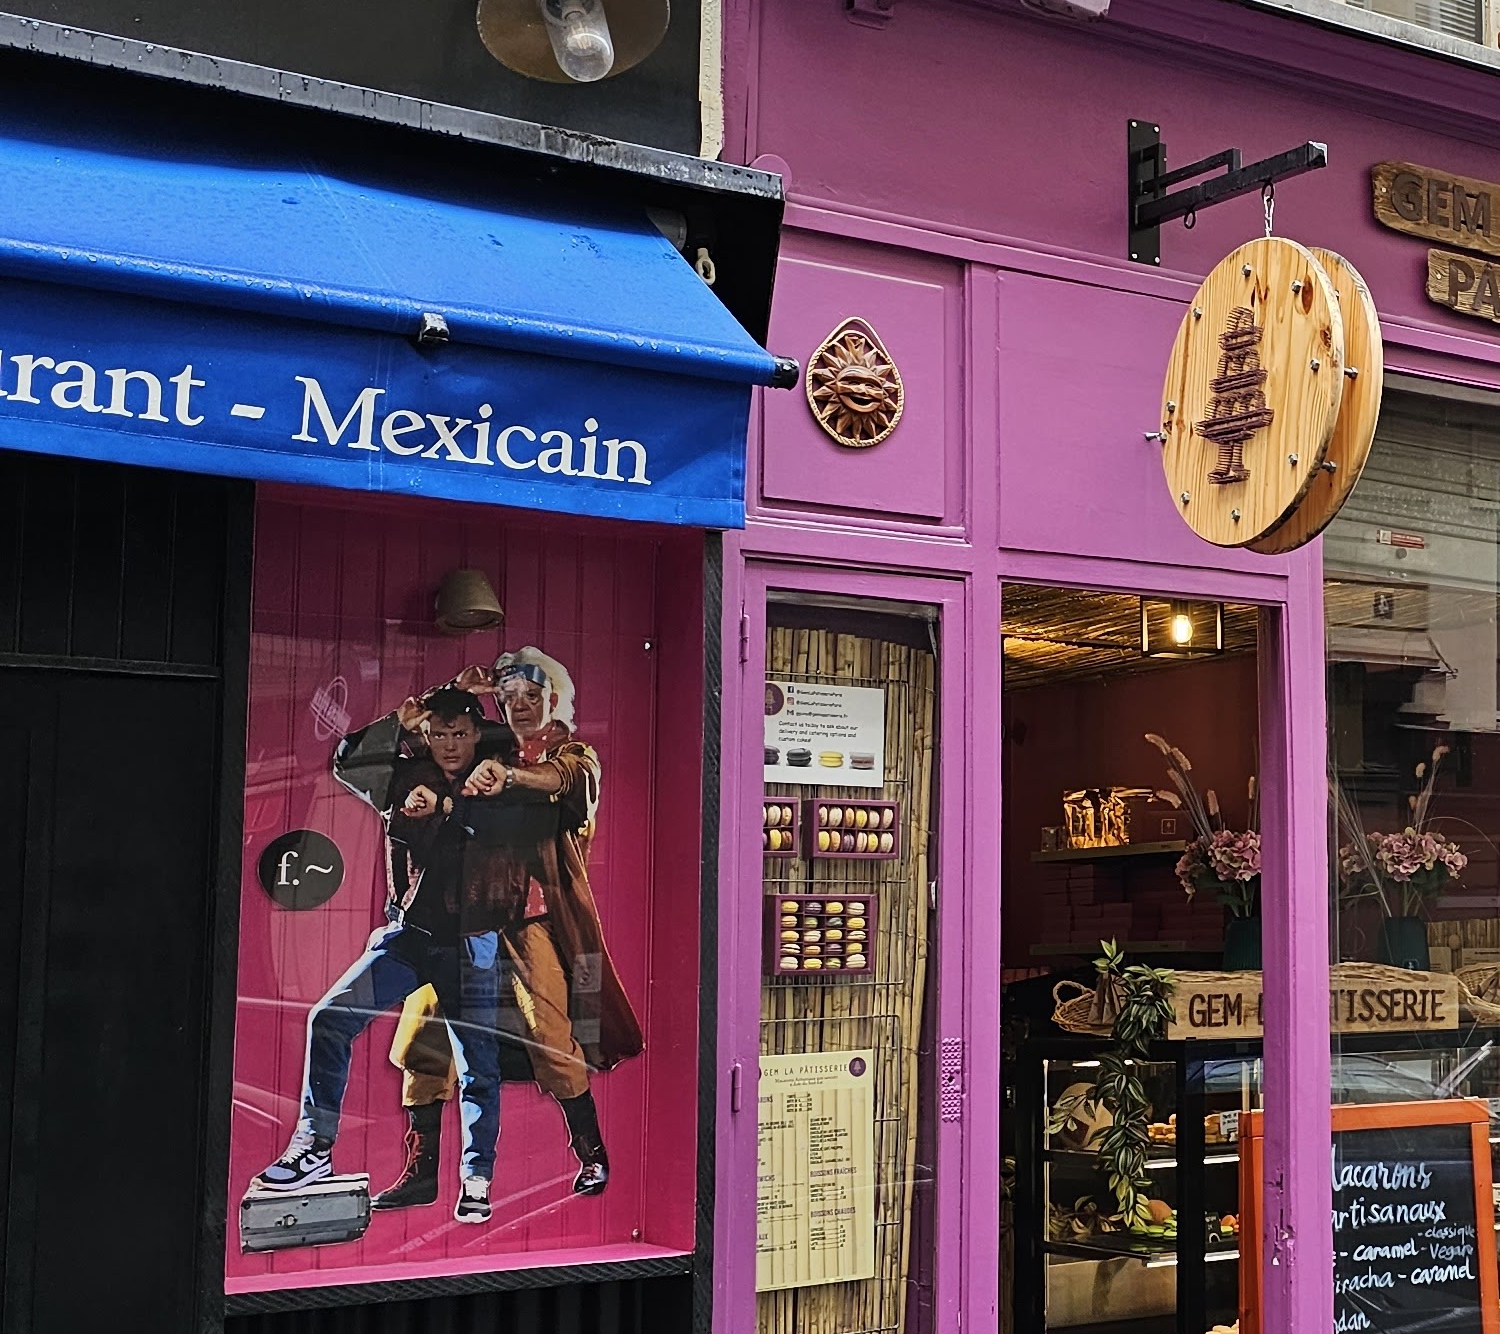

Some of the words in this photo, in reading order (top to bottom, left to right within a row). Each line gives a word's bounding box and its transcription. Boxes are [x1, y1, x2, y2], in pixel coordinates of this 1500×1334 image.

[1391, 170, 1492, 238] GEM
[0, 350, 206, 426] rant
[291, 375, 652, 486] Mexicain
[1188, 992, 1243, 1028] GEM
[1330, 987, 1446, 1024] TISSERIE
[763, 1068, 779, 1077] GEM
[784, 1067, 794, 1076] LA
[799, 1063, 848, 1074] PÂTISSERIE
[1353, 1238, 1419, 1262] caramel
[1430, 1243, 1474, 1260] Vegan
[1335, 1266, 1395, 1294] iracha
[1410, 1257, 1476, 1286] caramel
